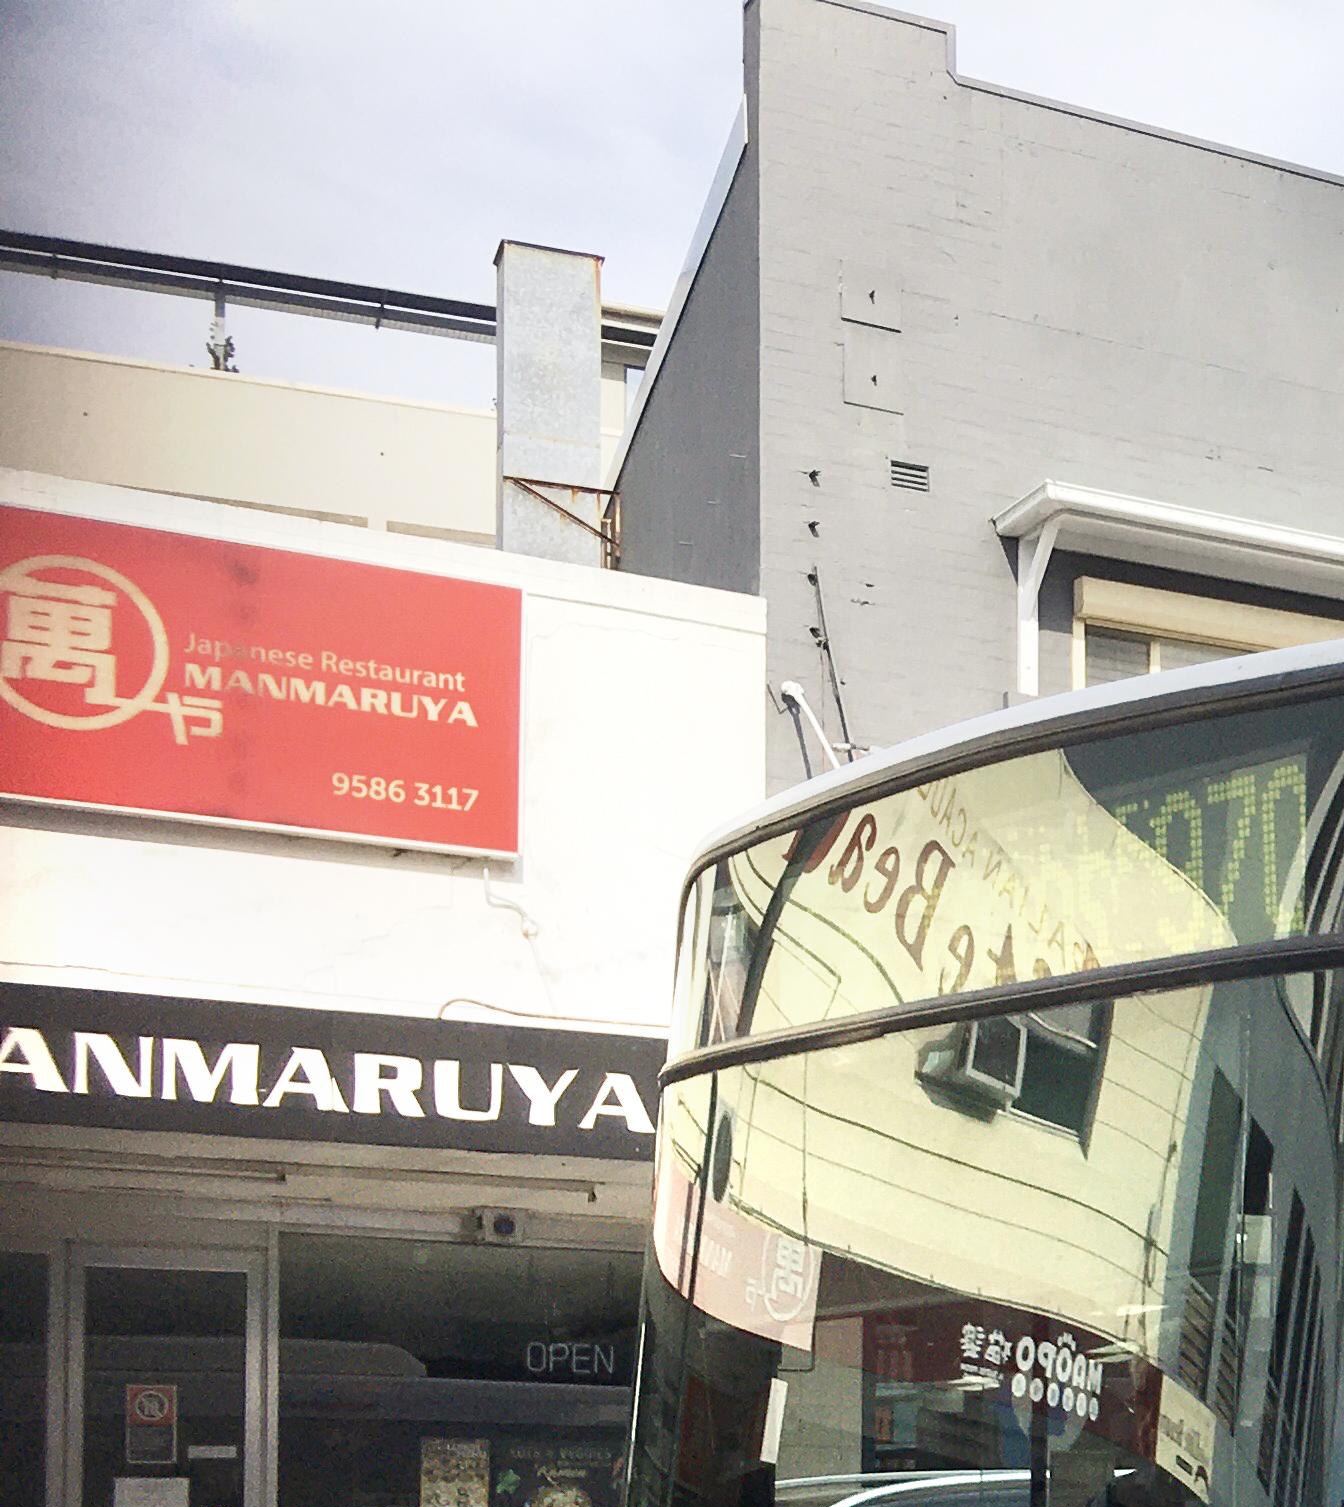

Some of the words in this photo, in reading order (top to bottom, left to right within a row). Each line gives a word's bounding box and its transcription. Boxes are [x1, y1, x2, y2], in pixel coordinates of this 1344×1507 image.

[184, 631, 314, 671] Japanese
[320, 650, 467, 693] Restaurant
[184, 662, 480, 728] MANMARUYA
[331, 772, 406, 804] 9586
[413, 782, 480, 812] 3117
[0, 1025, 656, 1134] ANMARUYA
[524, 1340, 615, 1377] OPEN
